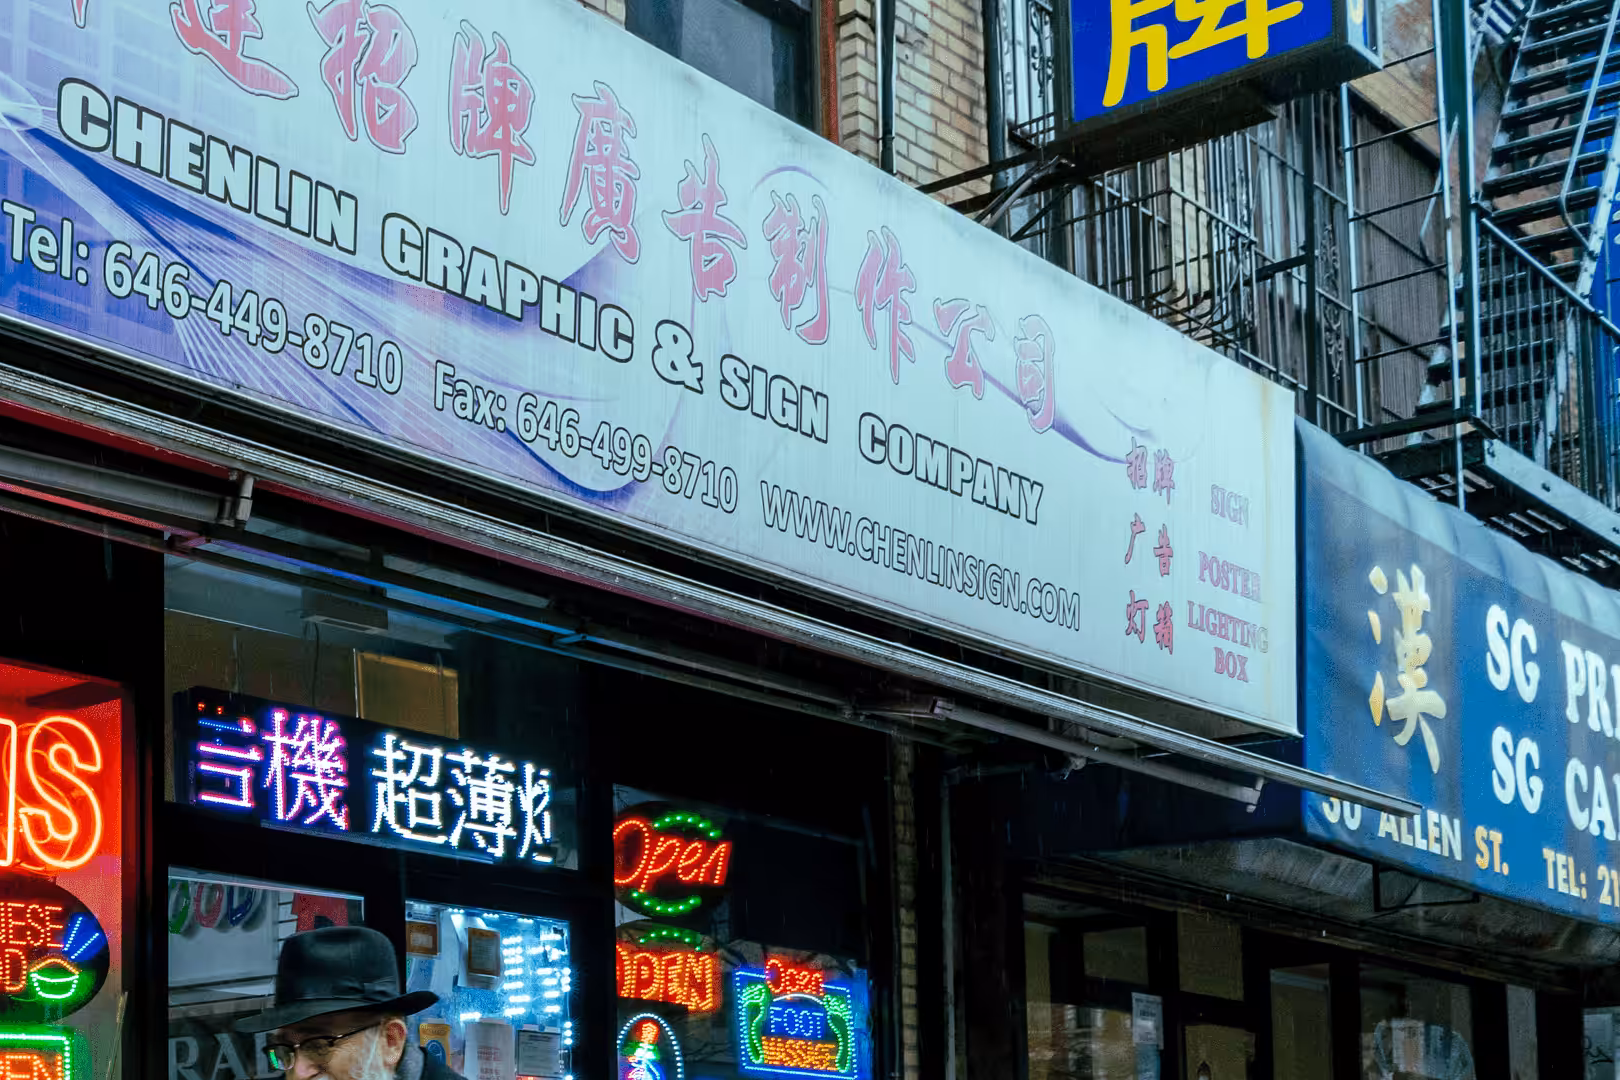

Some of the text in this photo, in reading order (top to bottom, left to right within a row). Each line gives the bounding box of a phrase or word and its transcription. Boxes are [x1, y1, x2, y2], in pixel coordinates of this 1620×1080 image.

[56, 77, 1044, 525] CHENLIN GRAPHIC & SIGN COMPANY
[1, 201, 1081, 632] Tel: 646-449-8710 Fax: 646-499-8710 WWW.CHENLINSIGN.COM
[1211, 484, 1249, 528] SIGN
[1198, 551, 1262, 603] POSTER
[1187, 600, 1268, 653] LIGHTING
[1214, 646, 1249, 683] BOX
[1486, 604, 1540, 703] SG
[1492, 726, 1543, 814] SG
[1542, 848, 1587, 900] TEL:
[770, 1007, 823, 1038] FOOT
